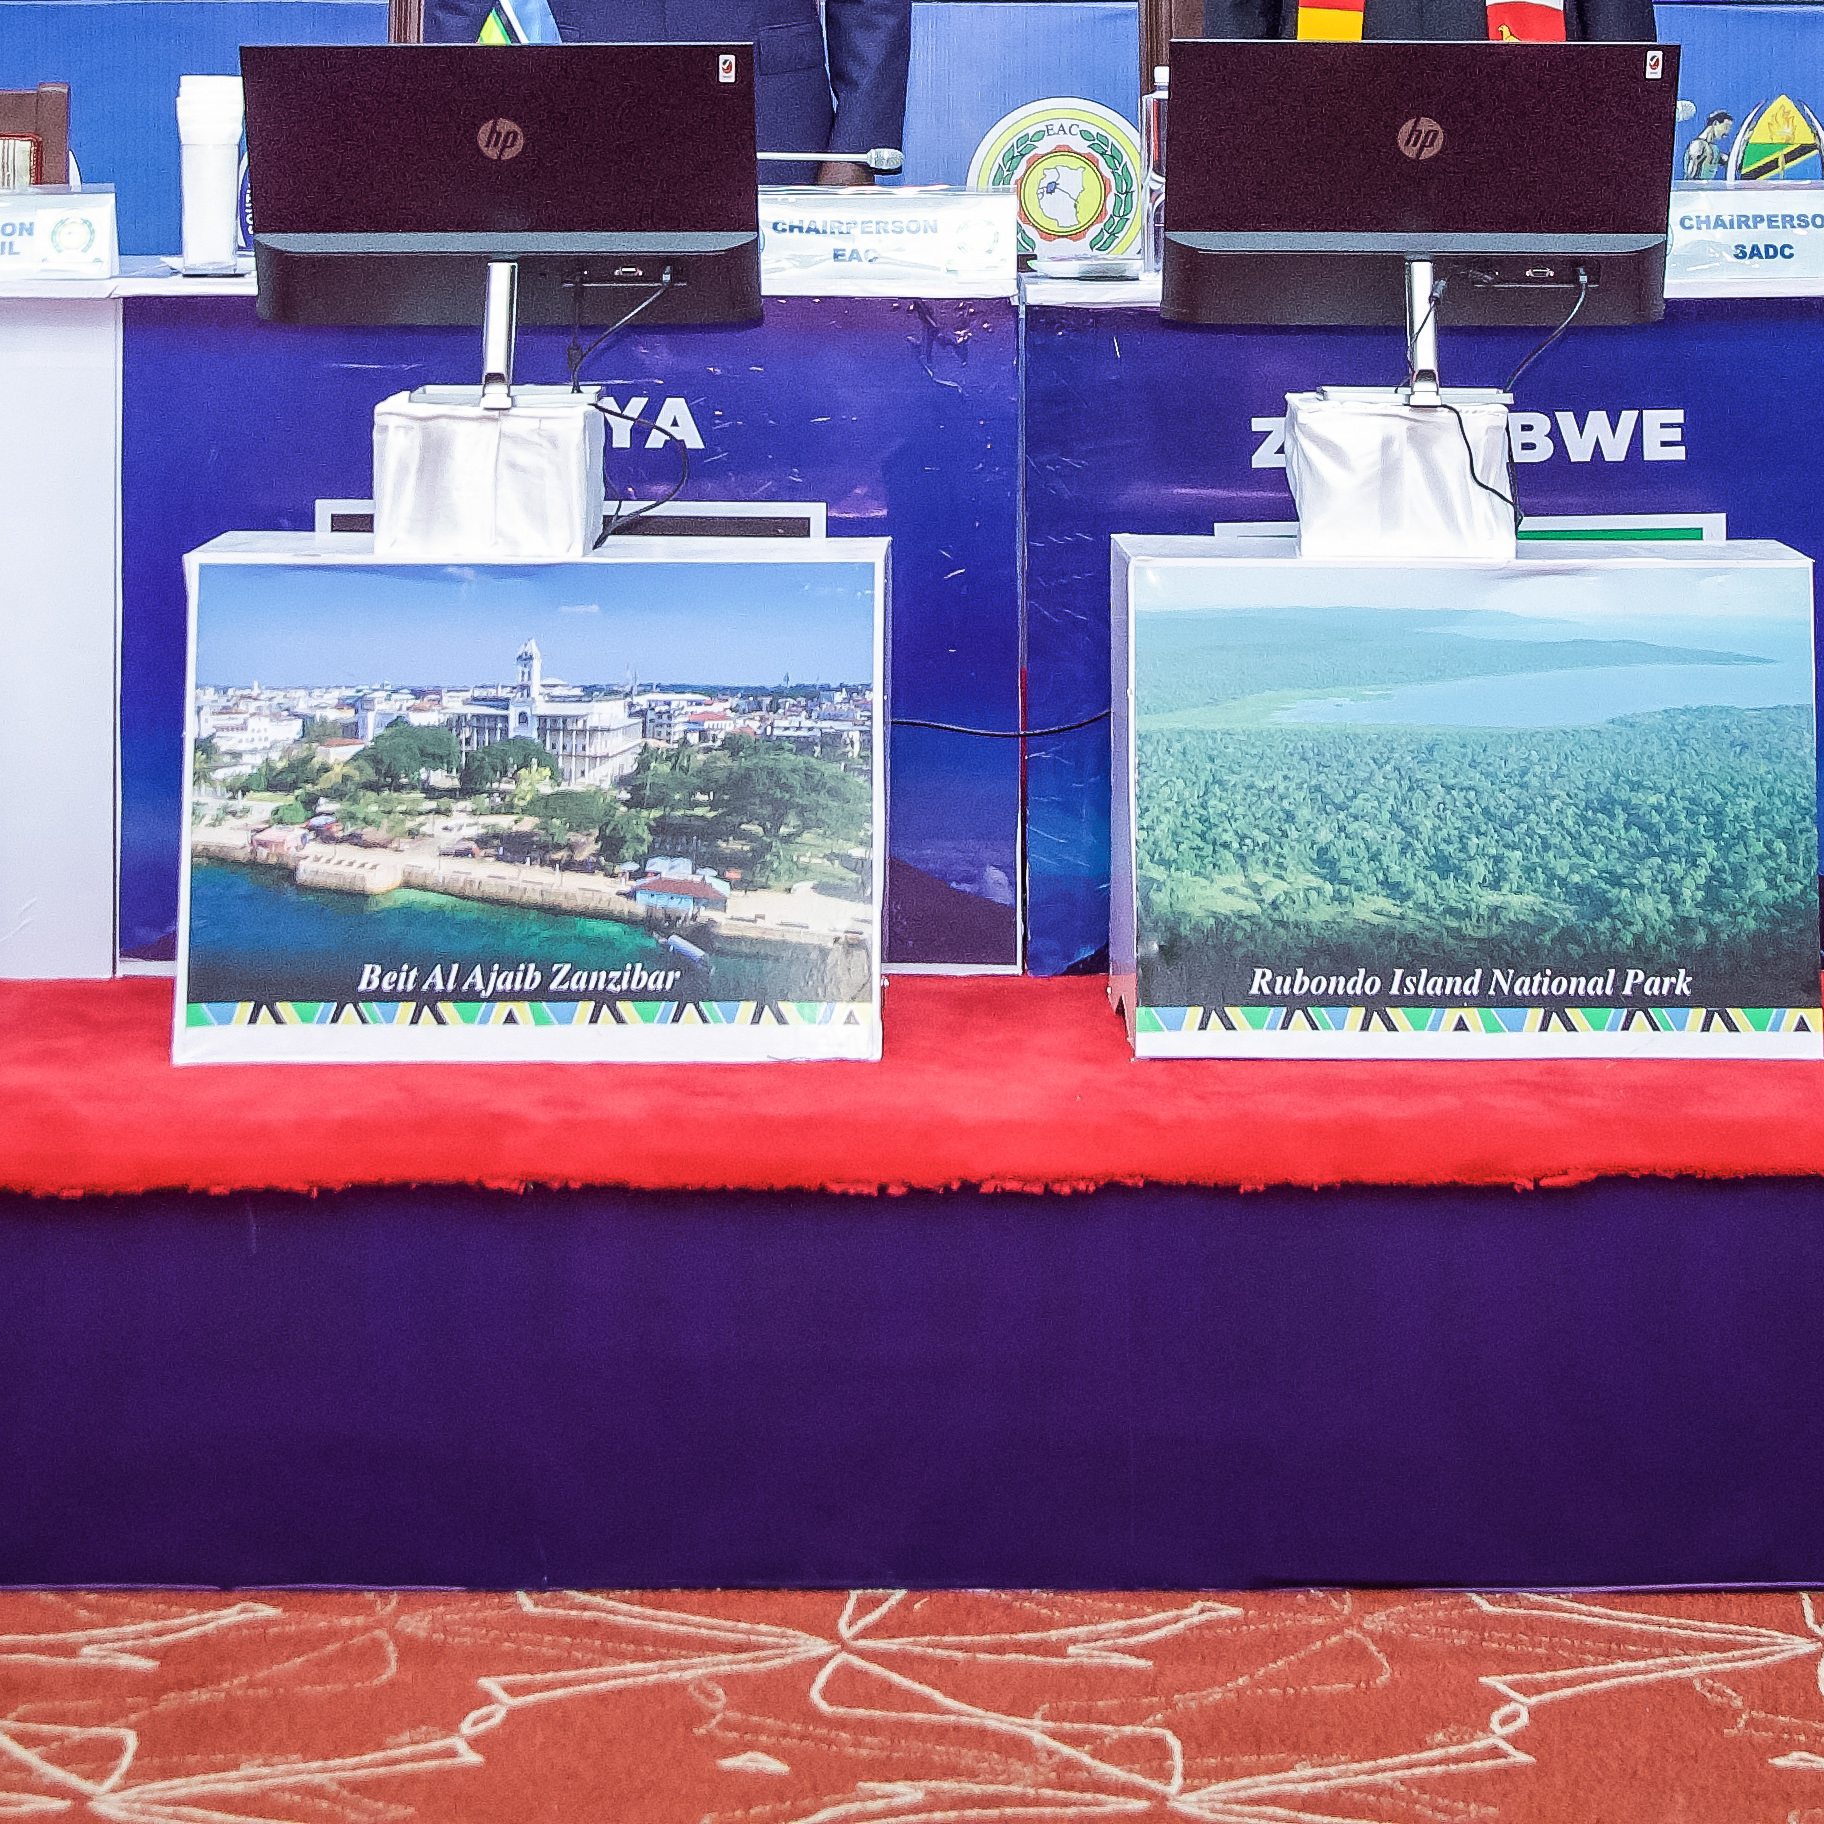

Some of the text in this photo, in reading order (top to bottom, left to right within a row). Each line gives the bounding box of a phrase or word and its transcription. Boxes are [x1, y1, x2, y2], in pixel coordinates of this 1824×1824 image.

[482, 118, 520, 160] hp
[1045, 122, 1080, 137] EAC
[1400, 117, 1440, 159] hp
[772, 219, 939, 235] CHAIRPERSON
[833, 248, 879, 263] EAC
[1733, 243, 1795, 261] SADC
[600, 397, 706, 450] YA
[358, 962, 681, 997] Beit Al Ajaib Zanzibar
[1249, 967, 1694, 996] Rubondo Island National Park
